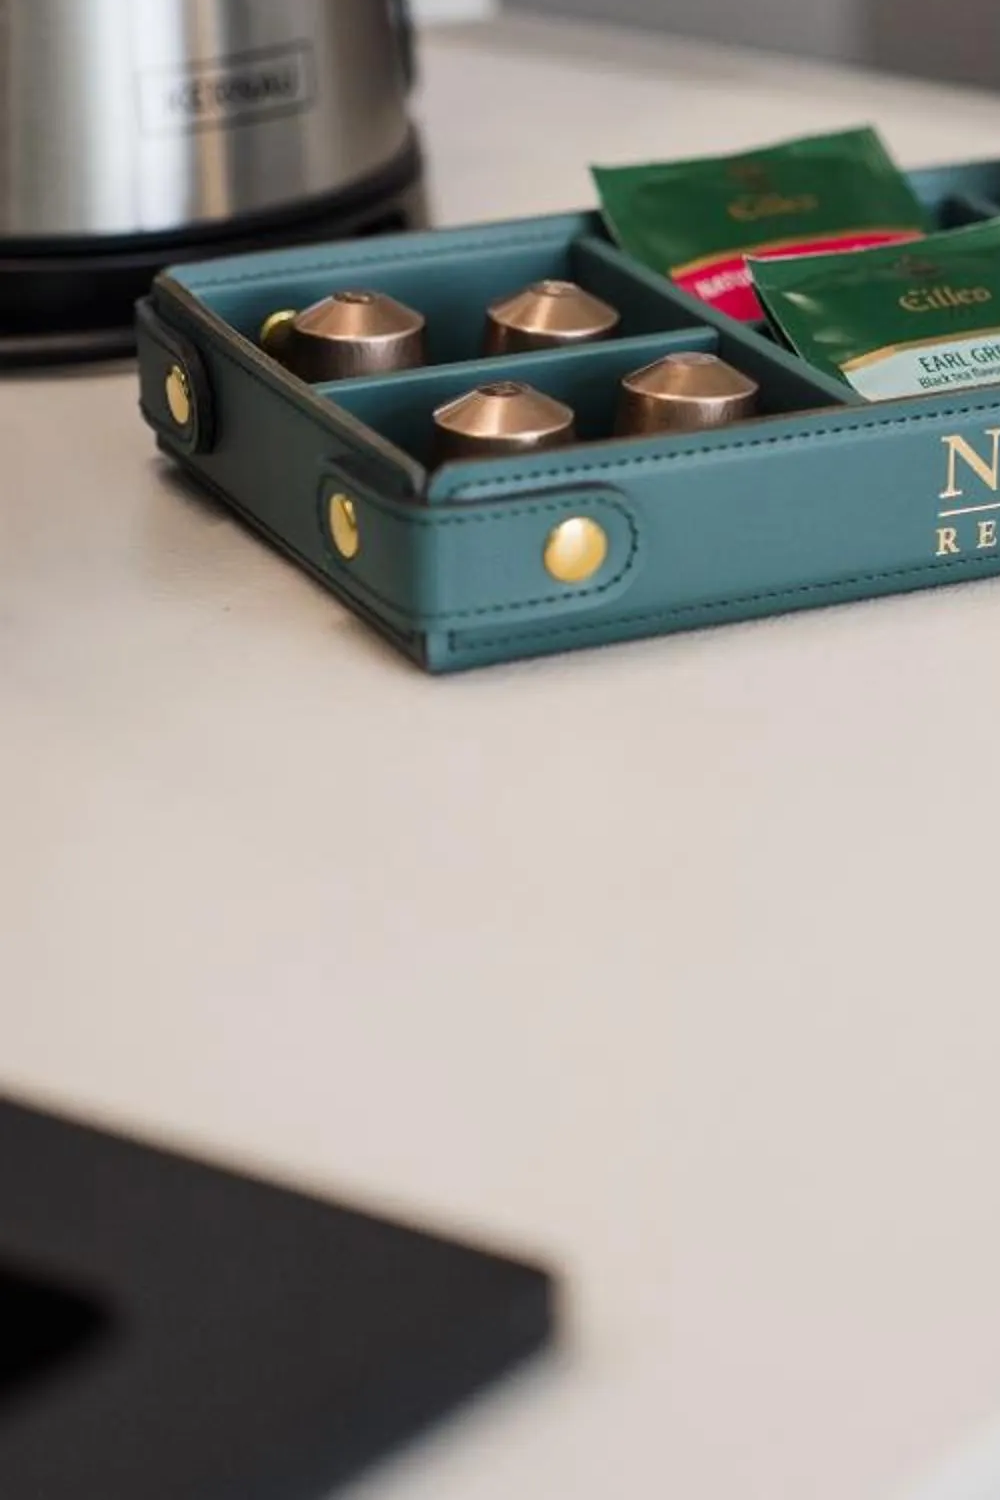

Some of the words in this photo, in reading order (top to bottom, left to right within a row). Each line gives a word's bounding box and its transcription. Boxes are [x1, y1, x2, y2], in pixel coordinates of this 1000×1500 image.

[918, 350, 972, 374] EARL
[917, 372, 951, 389] Black
[951, 369, 971, 382] tea
